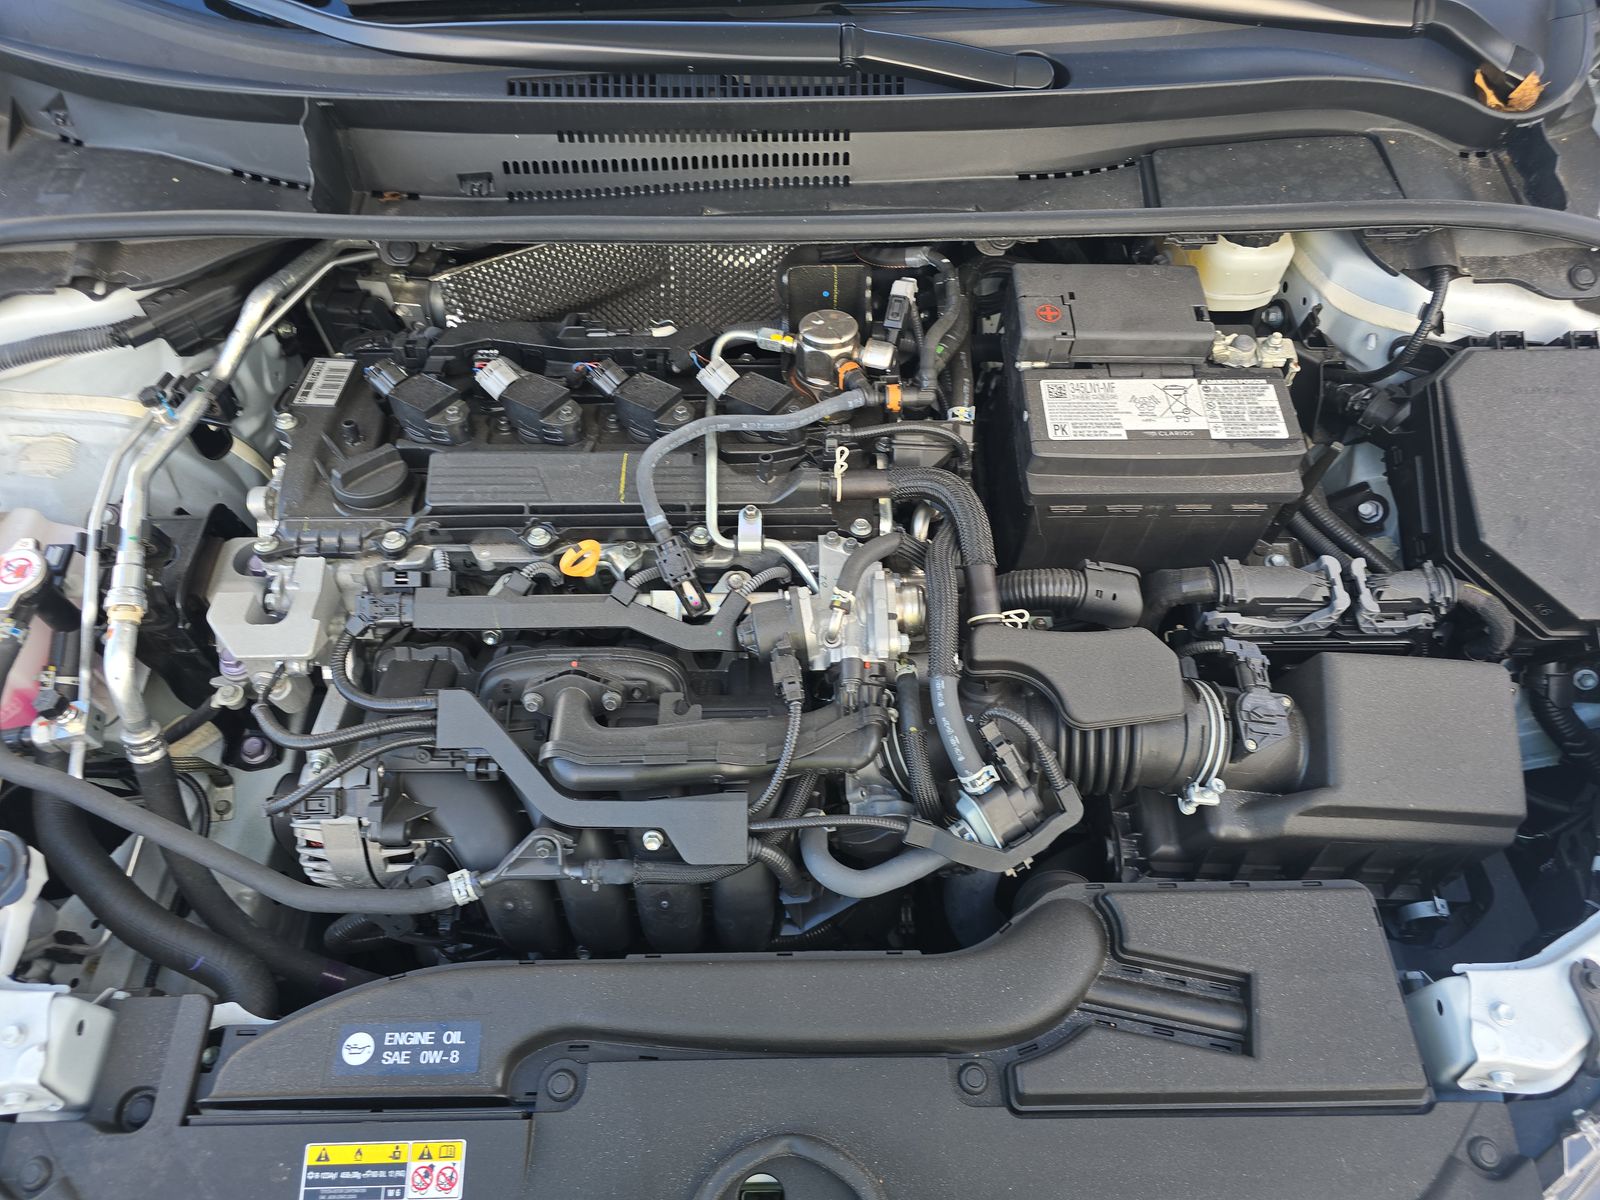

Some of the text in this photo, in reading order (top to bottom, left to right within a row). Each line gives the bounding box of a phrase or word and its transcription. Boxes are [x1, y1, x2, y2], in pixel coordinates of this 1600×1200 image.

[1053, 424, 1069, 436] PK
[384, 1030, 465, 1046] ENGINE OIL
[381, 1050, 460, 1065] SAE 0W-8
